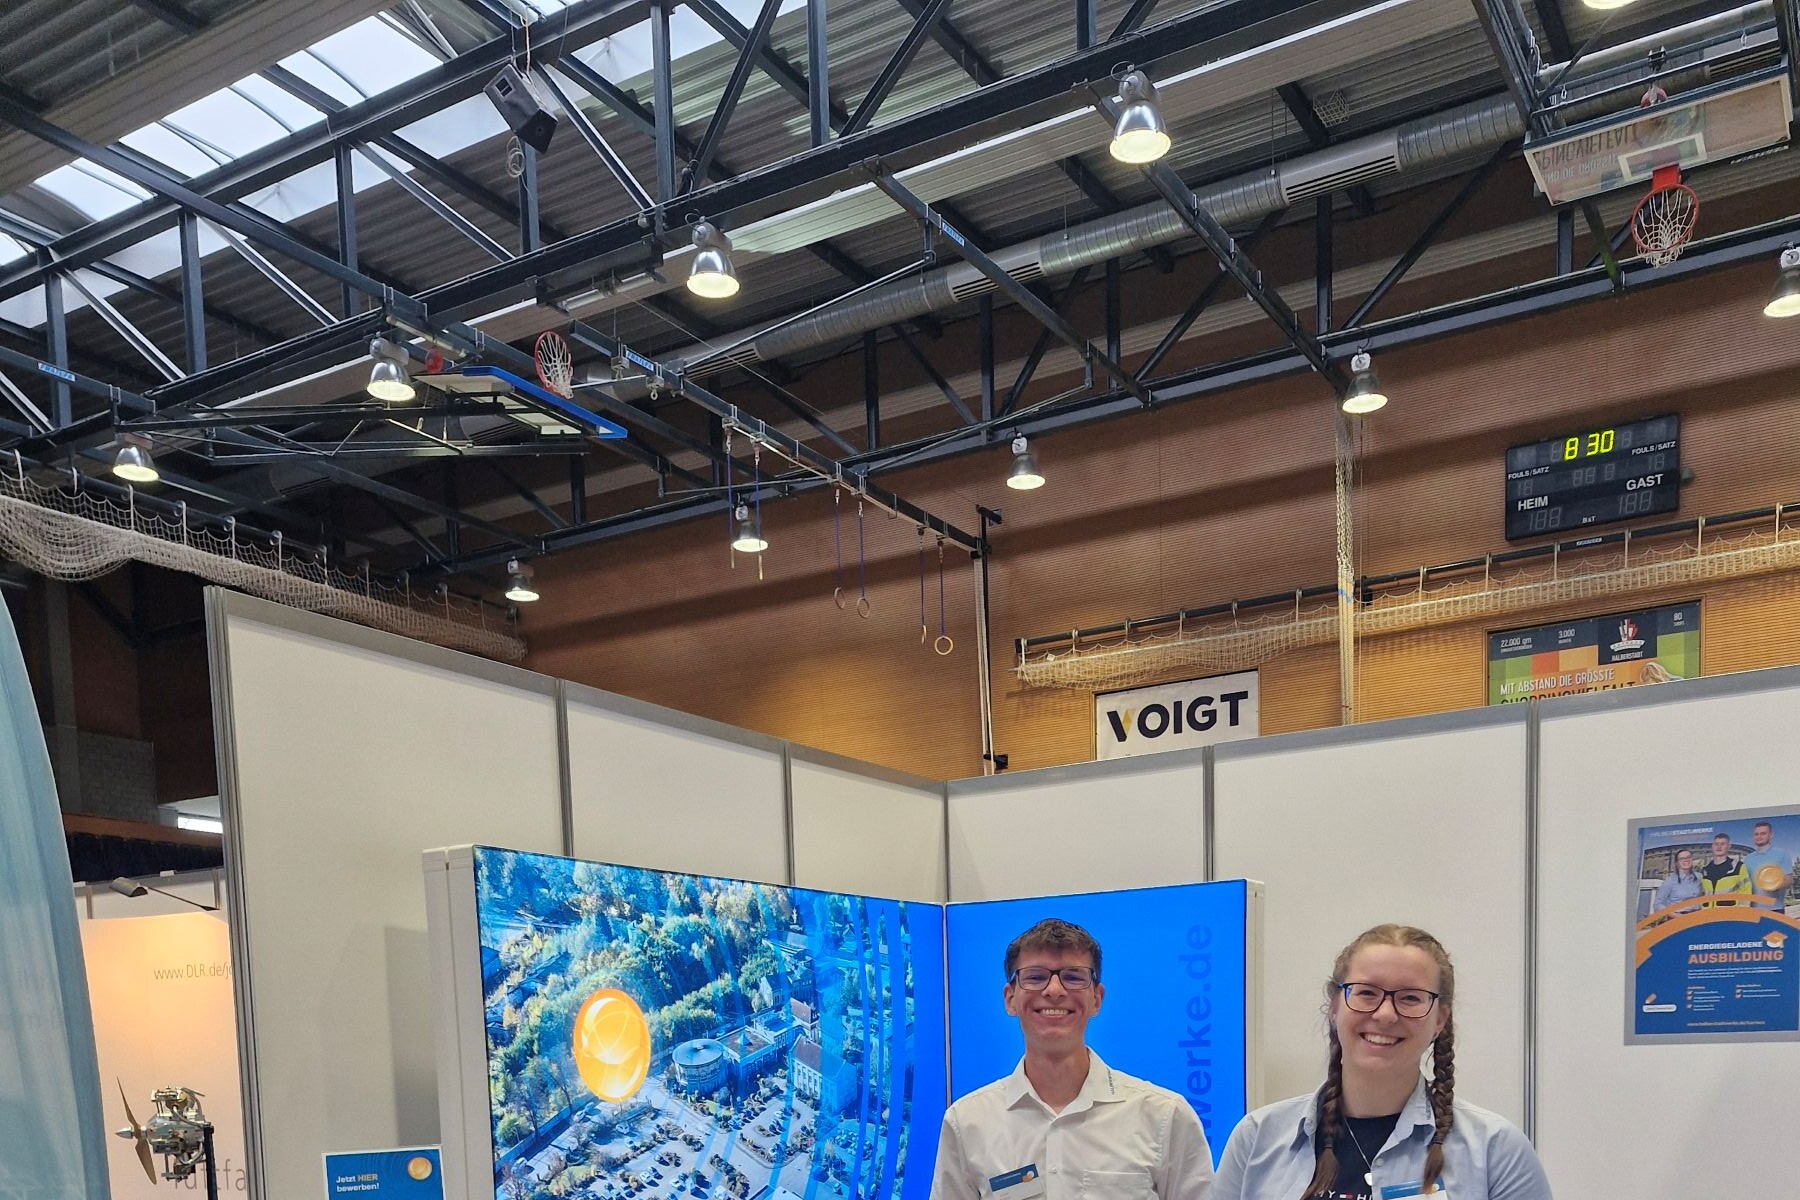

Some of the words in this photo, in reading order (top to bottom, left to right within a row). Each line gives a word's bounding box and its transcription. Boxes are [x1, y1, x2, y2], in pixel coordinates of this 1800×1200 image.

[1631, 441, 1676, 456] FOULS/SATZ
[1508, 466, 1550, 480] FOULS/SATZ
[1626, 474, 1664, 491] GAST
[1518, 495, 1549, 511] HEIM
[1558, 629, 1575, 639] 3.000
[1500, 683, 1515, 695] MIT
[1518, 677, 1557, 692] ABSTAND
[1560, 675, 1573, 686] DIE
[1107, 690, 1249, 742] VOIGT
[1688, 941, 1763, 951] ENERGIEGELADENE
[1688, 950, 1784, 964] AUSBILDUNG
[337, 1183, 379, 1192] bewerben!
